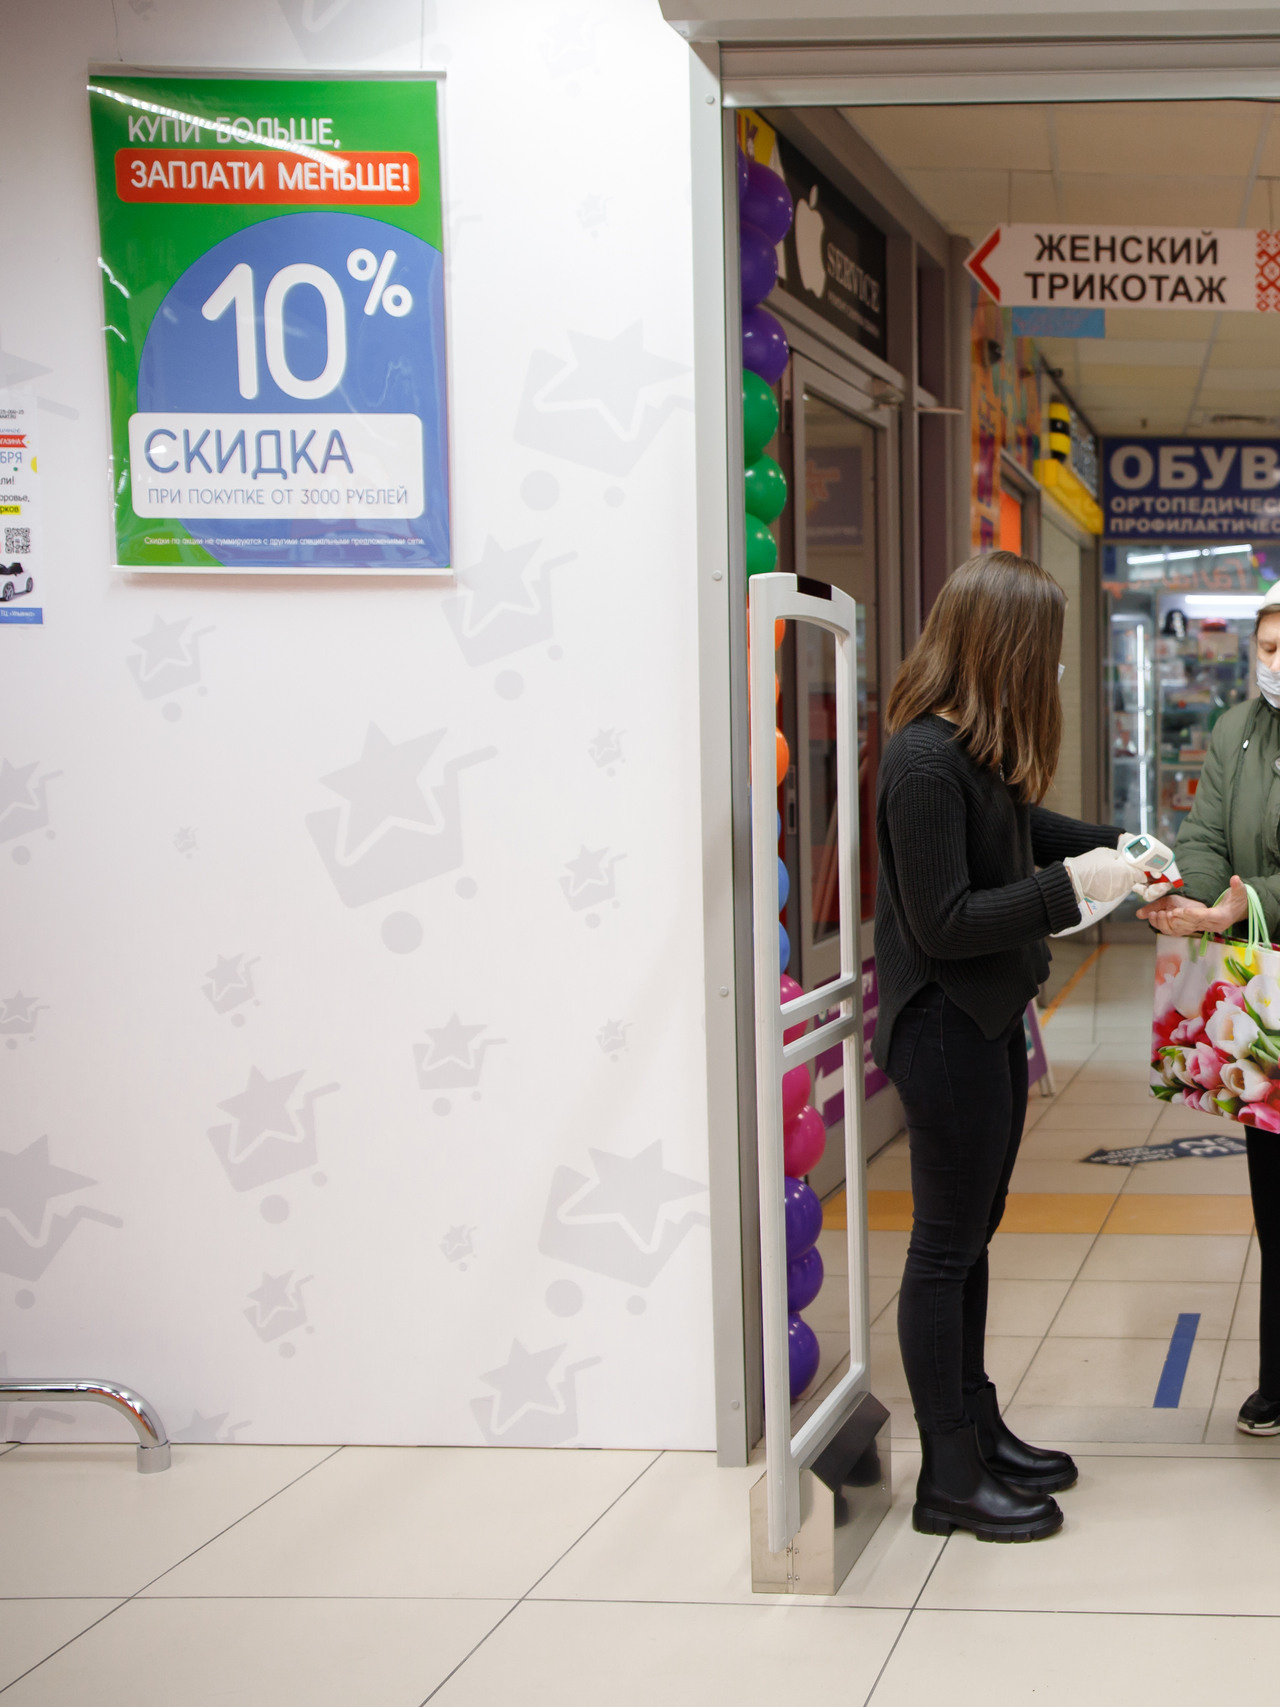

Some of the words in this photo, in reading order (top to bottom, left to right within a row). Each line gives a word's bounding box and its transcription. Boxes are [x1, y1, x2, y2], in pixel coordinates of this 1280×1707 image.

[127, 115, 200, 143] КУПИ
[216, 117, 342, 149] БОЛЬШЕ,
[130, 159, 264, 190] ЗАПЛАТИ
[277, 161, 411, 192] МЕНЬШЕ!
[1033, 229, 1218, 265] ЖЕНСКИЙ
[826, 241, 880, 314] SERVICE
[1024, 271, 1227, 304] ТРИКОТАЖ
[144, 428, 354, 480] СКИДКА
[148, 488, 181, 504] ПРИ
[188, 488, 264, 505] ПОКУПКЕ
[271, 488, 294, 505] ОТ
[301, 488, 340, 505] 3000
[346, 485, 408, 505] РУБЛЕЙ
